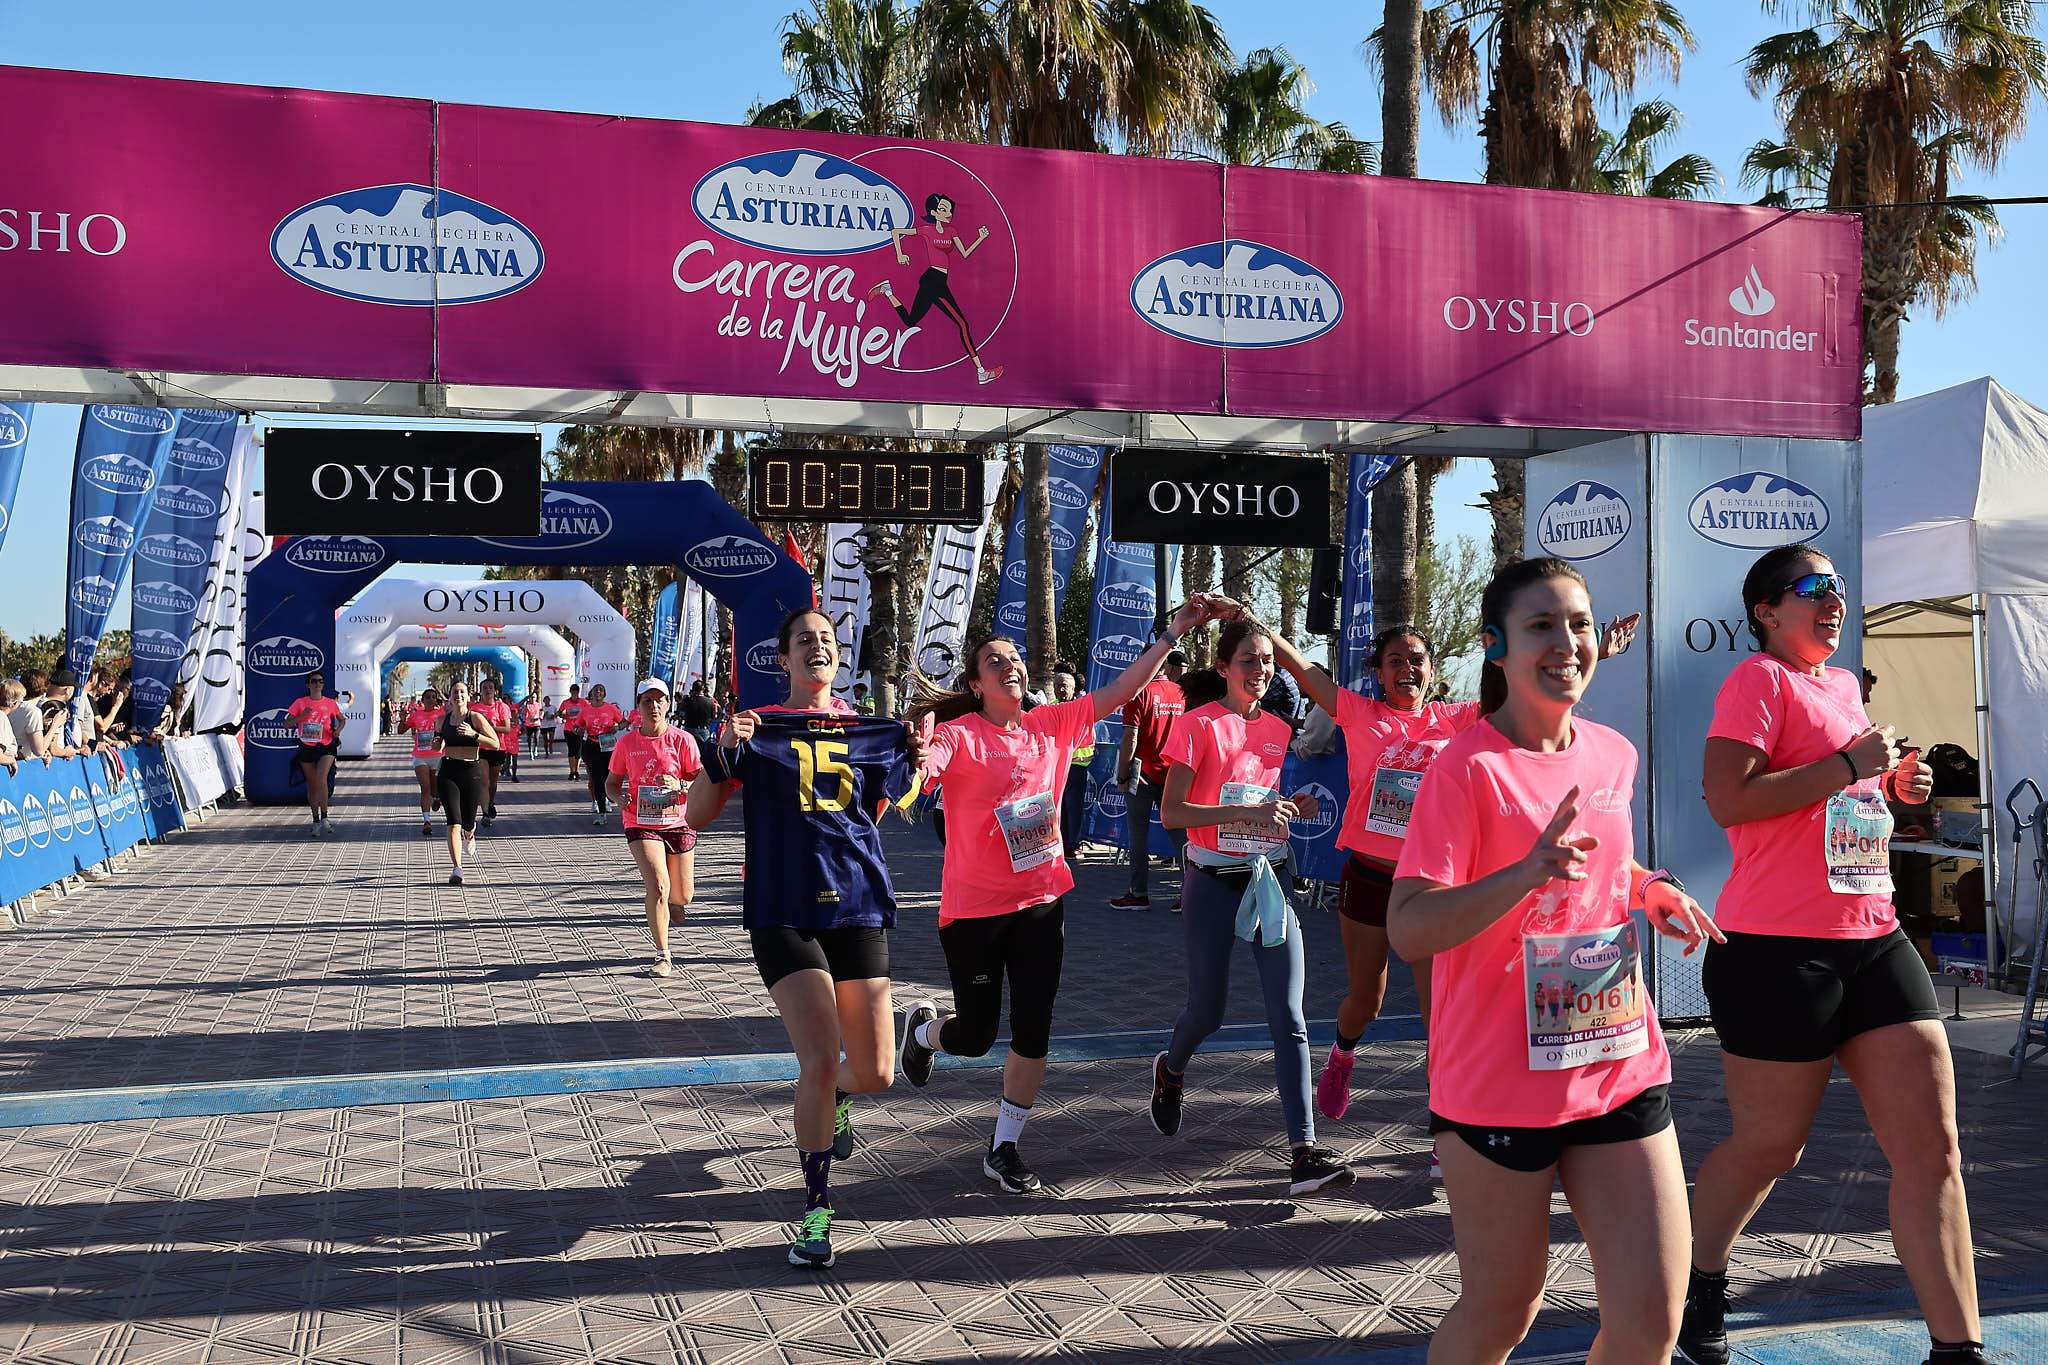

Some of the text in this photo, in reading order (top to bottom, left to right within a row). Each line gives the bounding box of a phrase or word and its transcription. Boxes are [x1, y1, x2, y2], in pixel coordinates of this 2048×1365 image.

[744, 181, 891, 202] CENTRAL LECHERA
[709, 181, 896, 232] ASTURIANA
[0, 208, 127, 256] SHO
[335, 222, 421, 238] CENTRAL
[292, 223, 524, 278] ASTURIANA
[671, 239, 859, 304] Carrera
[1180, 273, 1321, 292] CENTRAL LECHERA
[1147, 275, 1328, 323] ASTURIANA
[1443, 295, 1596, 337] OYSHO
[717, 299, 922, 388] de la Mujer
[1684, 318, 1818, 352] Santander
[97, 404, 168, 430] ASTURIANA
[86, 463, 150, 489] ASTURIANA
[311, 462, 504, 504] OYSHO
[1148, 480, 1300, 518] OYSHO
[1720, 498, 1815, 508] CENTRAL LECHERA
[547, 506, 597, 514] LECHERA
[1556, 502, 1622, 520] CENTRAL LECHERA
[1698, 499, 1819, 531] ASTURIANA
[1543, 513, 1625, 544] ASTURIANA
[140, 541, 201, 563] ASTURIANA
[290, 545, 378, 563] ASTURIANA
[692, 551, 772, 568] ASTURIANA
[134, 588, 192, 610] ASTURIANA
[423, 589, 545, 613] OYSHO
[918, 524, 979, 681] OYSH
[349, 615, 387, 624] OYSHO
[578, 614, 615, 624] OYSHO
[250, 650, 320, 667] ASTURIANA
[596, 662, 630, 672] OYSHO
[344, 712, 366, 721] SHO
[249, 722, 300, 739] ASTURIA
[790, 737, 854, 812] 15
[1025, 825, 1046, 841] 016
[1374, 822, 1399, 833] OYSHO
[1835, 866, 1860, 875] CARRERA
[1860, 866, 1867, 874] DE
[1867, 866, 1874, 874] LA
[1839, 879, 1871, 888] OYSHO
[1576, 987, 1621, 1014] 016
[1590, 1016, 1607, 1028] 422
[1537, 1033, 1573, 1045] CARRERA
[1574, 1031, 1584, 1041] DE
[1584, 1030, 1594, 1040] LA
[1594, 1027, 1617, 1039] MUJER
[1546, 1047, 1588, 1062] OYSHO
